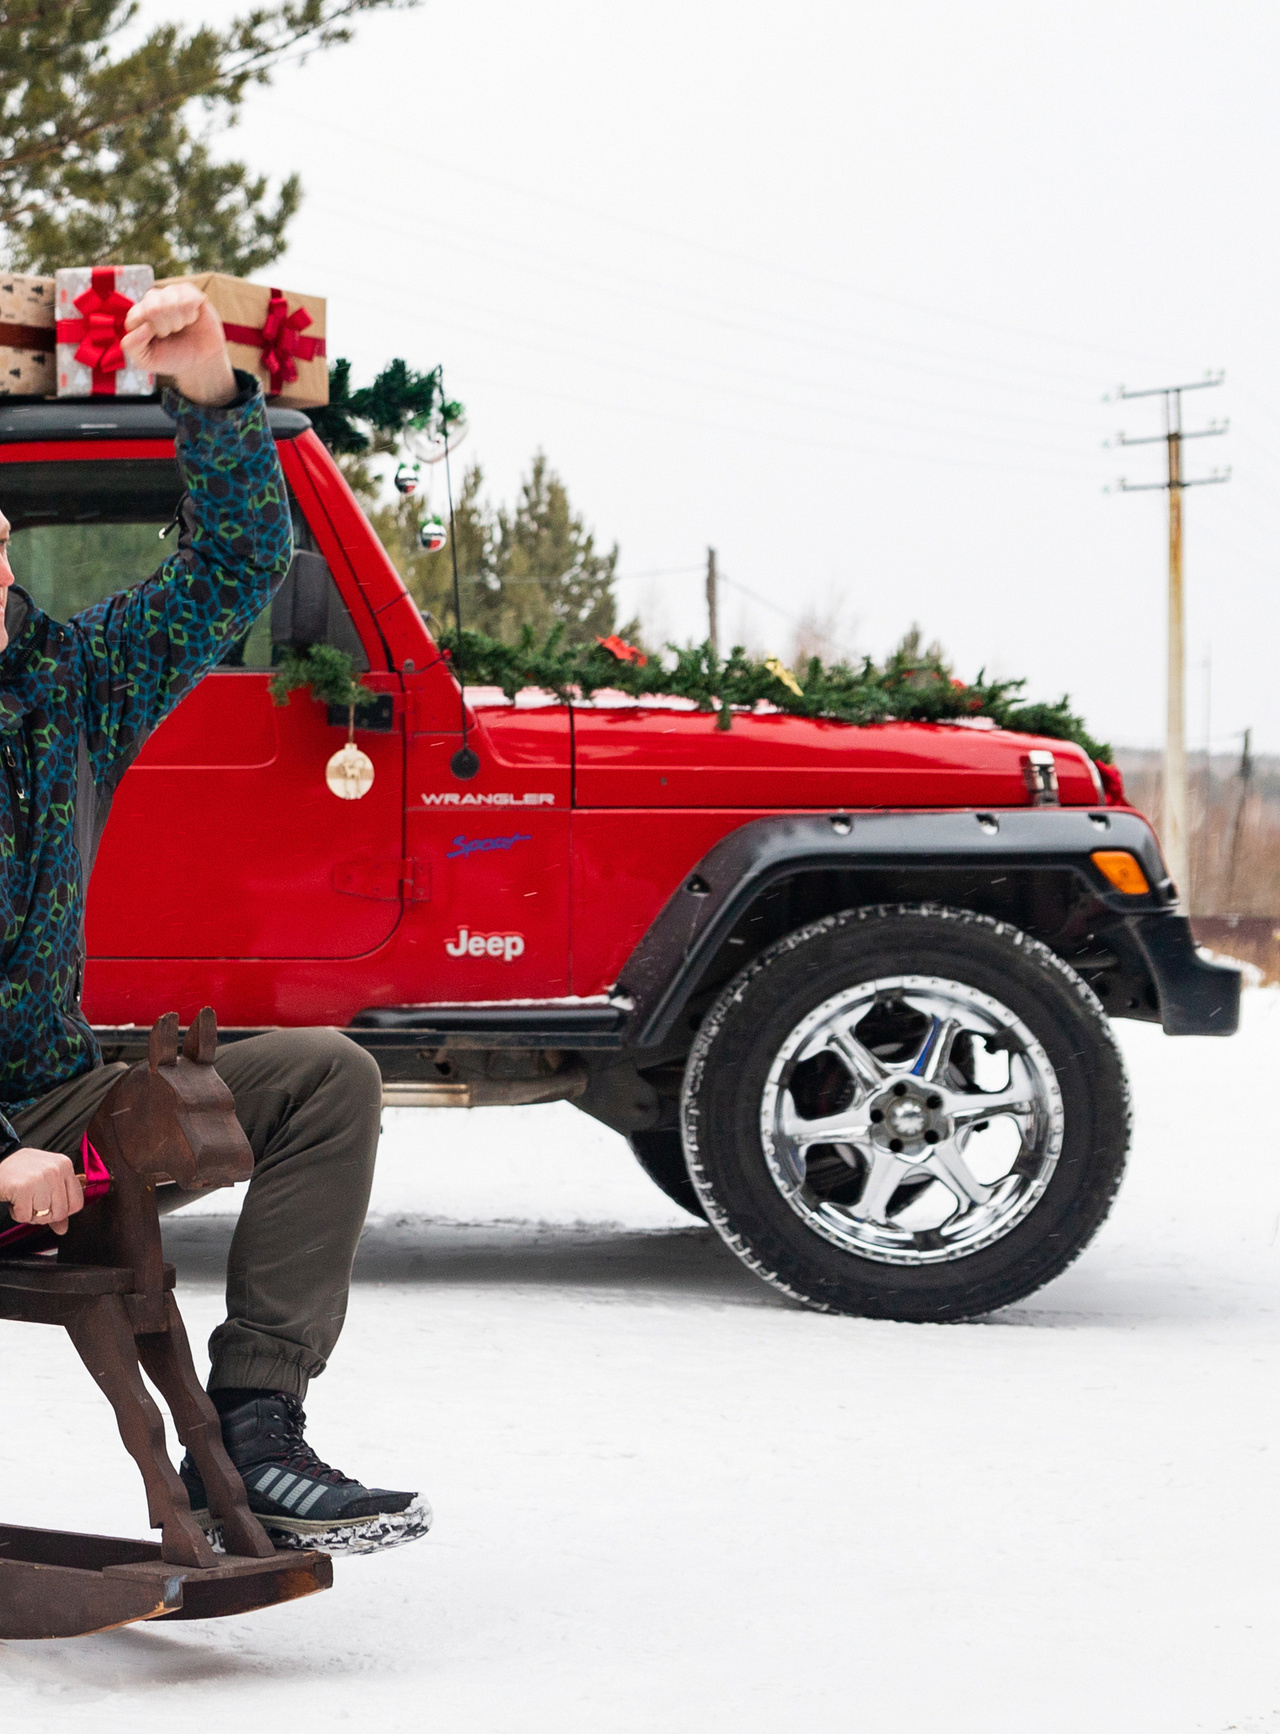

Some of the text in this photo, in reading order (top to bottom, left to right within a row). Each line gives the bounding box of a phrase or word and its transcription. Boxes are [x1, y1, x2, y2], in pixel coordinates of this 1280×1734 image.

[421, 792, 556, 806] WRANGLER
[446, 832, 533, 859] Sport
[446, 929, 525, 961] Jeep
